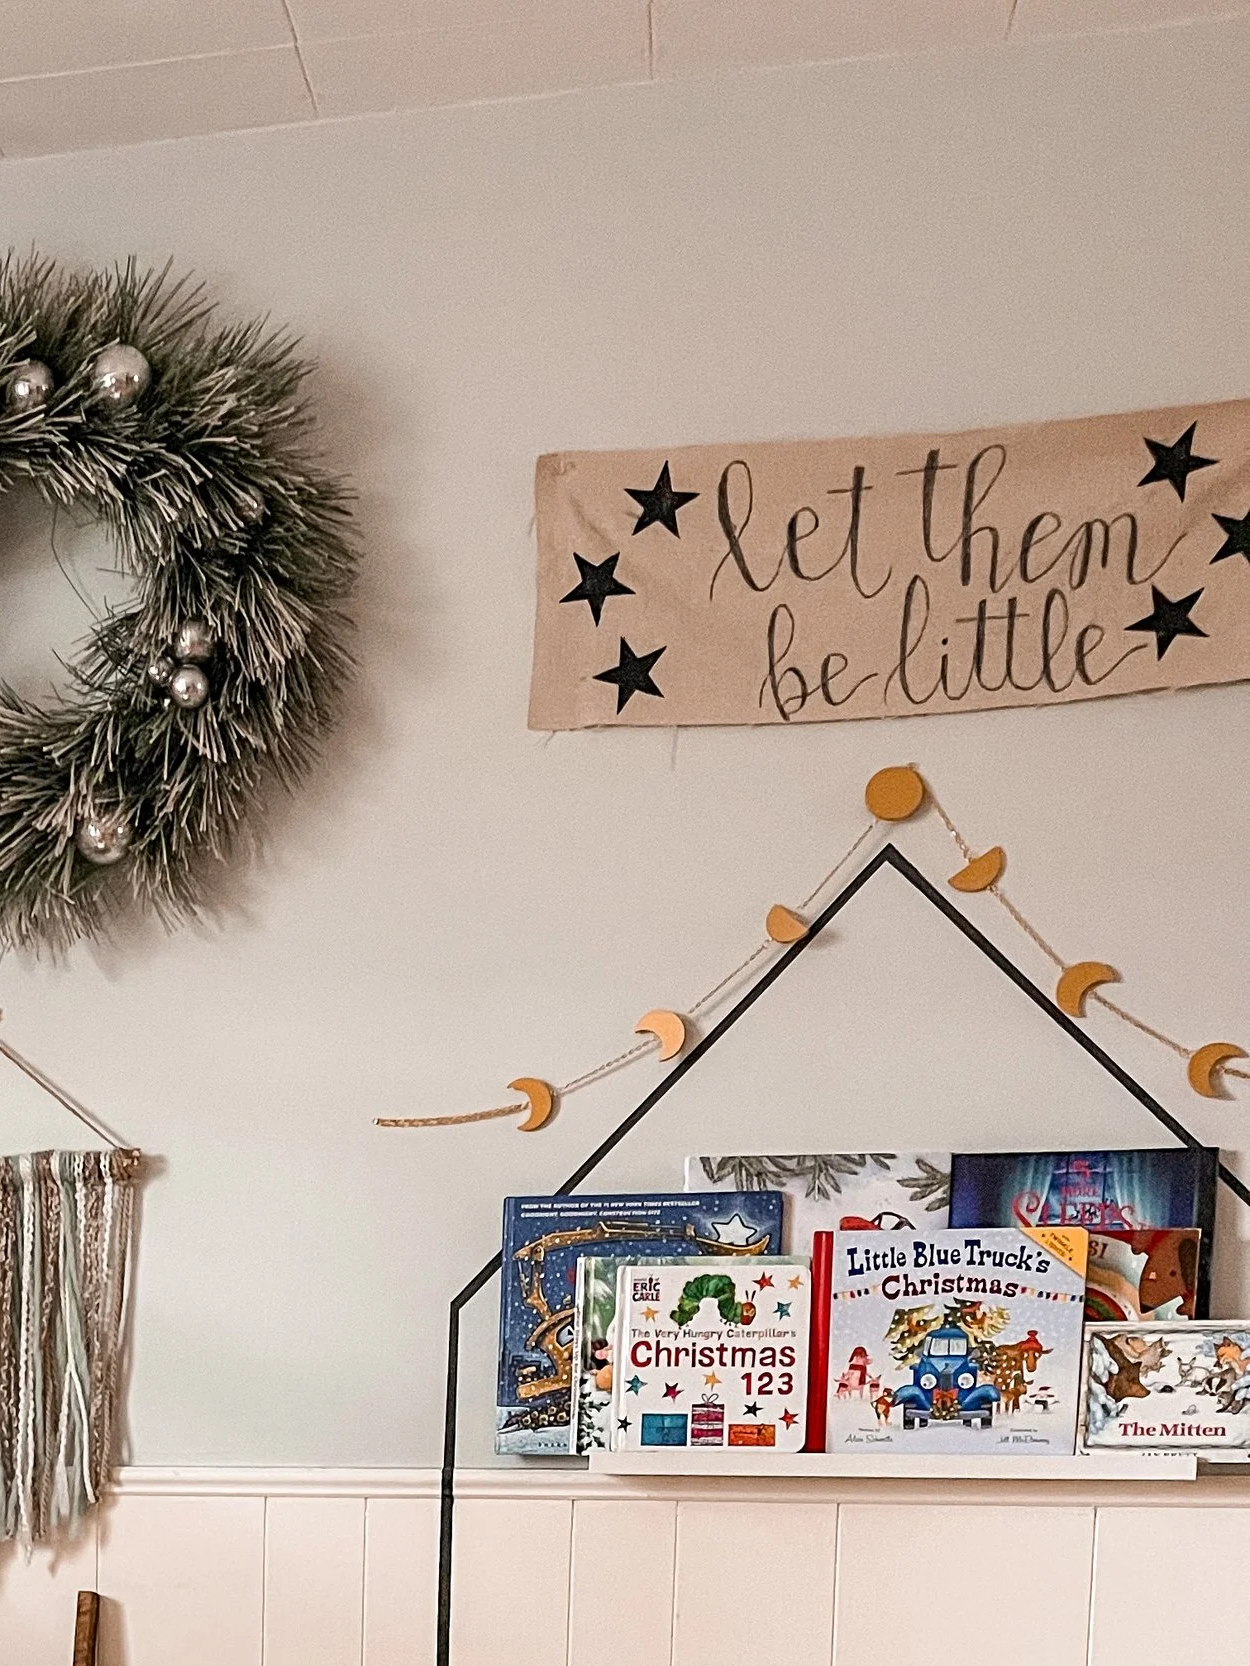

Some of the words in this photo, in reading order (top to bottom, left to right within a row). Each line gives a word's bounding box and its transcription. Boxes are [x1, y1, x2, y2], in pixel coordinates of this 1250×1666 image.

[710, 460, 892, 601] let
[895, 444, 1188, 592] them
[758, 603, 879, 721] be
[883, 574, 1149, 705] little
[846, 1246, 907, 1277] Little
[913, 1241, 961, 1268] Blue
[964, 1239, 1051, 1273] Truck's
[632, 1292, 661, 1302] CARLE
[633, 1277, 661, 1292] ERIC
[881, 1272, 1020, 1300] Christmas
[632, 1329, 650, 1338] The
[654, 1329, 679, 1341] Very
[683, 1329, 723, 1341] Hungry
[630, 1340, 796, 1368] Christmas
[740, 1372, 794, 1396] 123
[1118, 1422, 1156, 1437] The
[1159, 1422, 1226, 1437] Mitten
